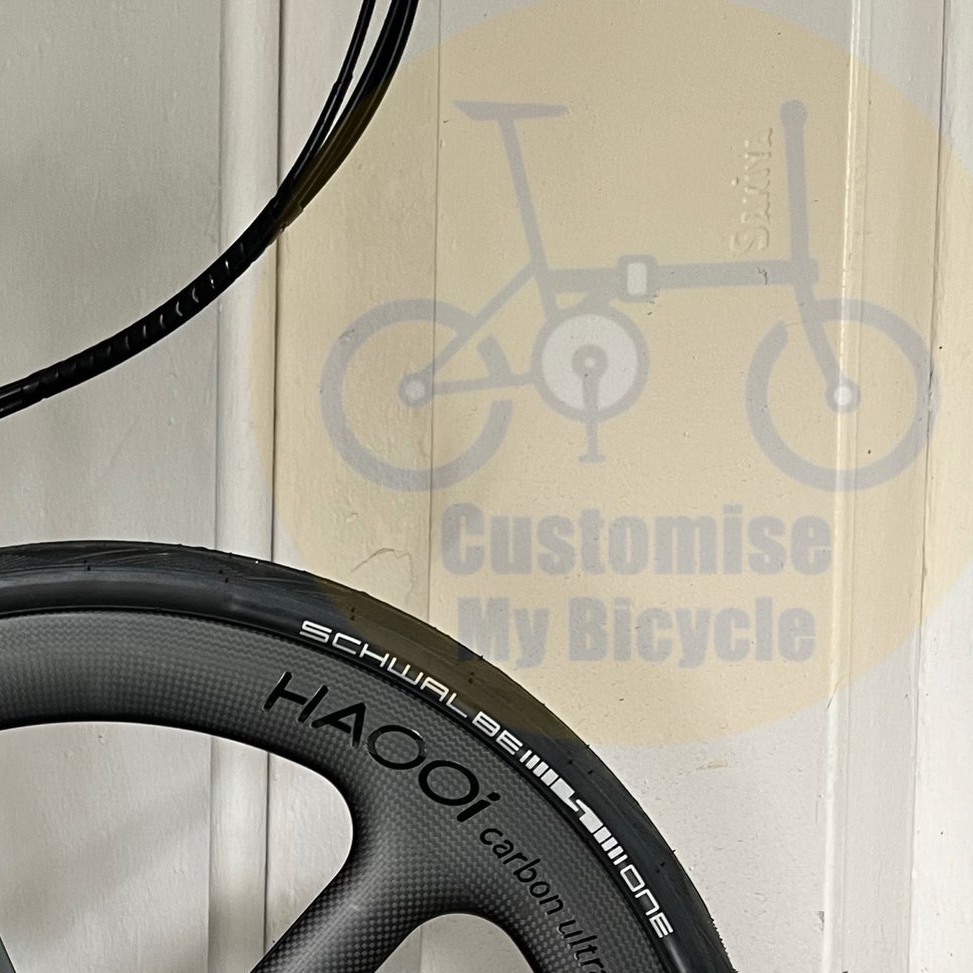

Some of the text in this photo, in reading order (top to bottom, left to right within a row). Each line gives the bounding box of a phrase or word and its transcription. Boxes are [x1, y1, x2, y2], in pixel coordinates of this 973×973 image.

[299, 620, 675, 939] SCHWALBE ONE
[479, 828, 565, 916] carbon
